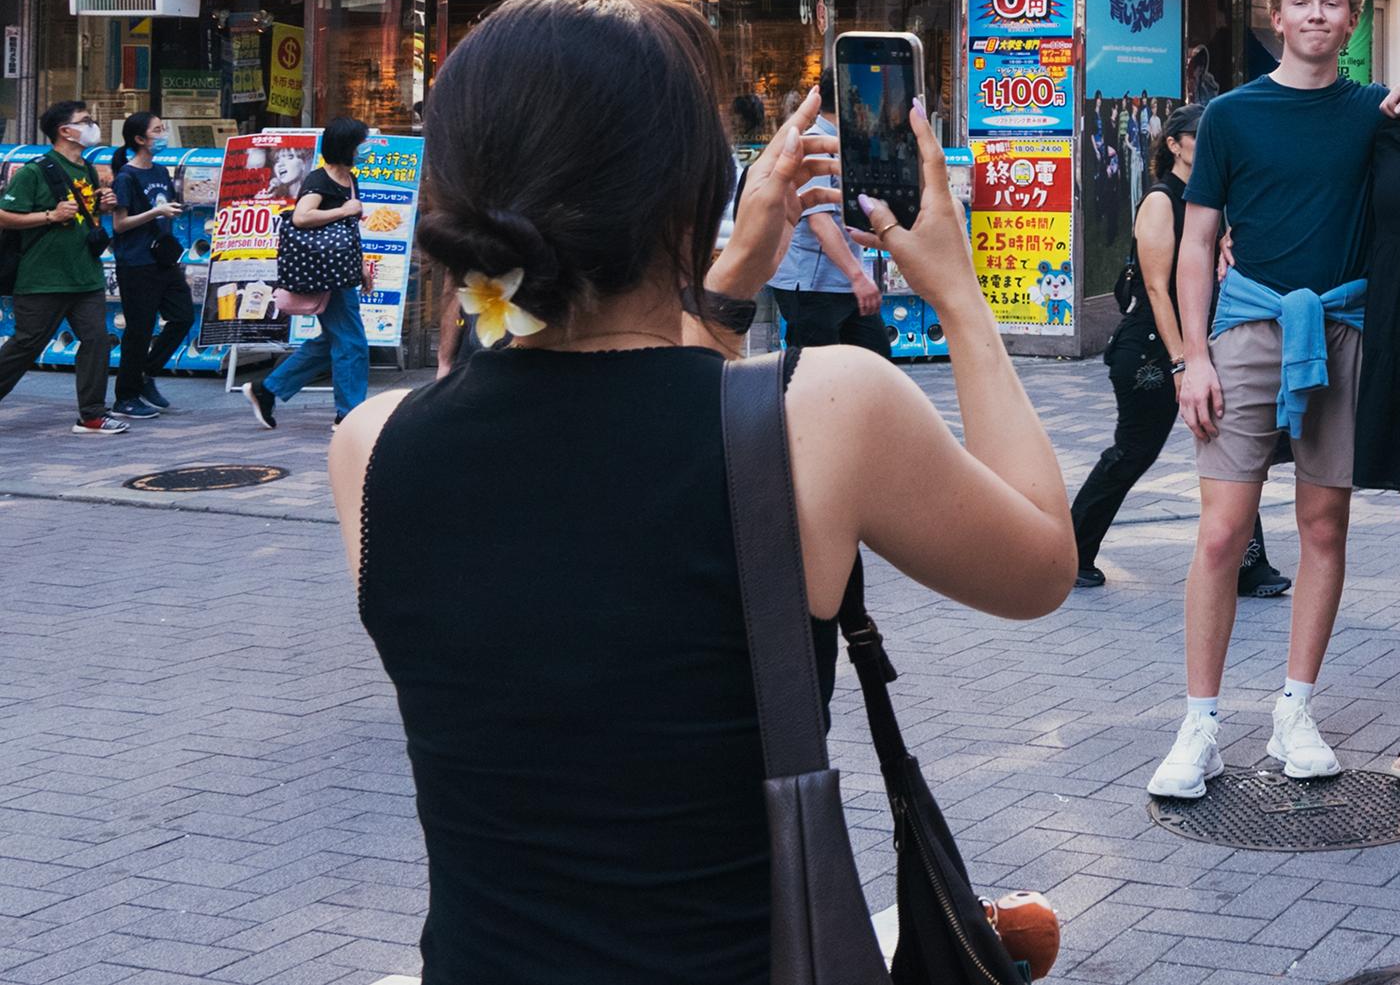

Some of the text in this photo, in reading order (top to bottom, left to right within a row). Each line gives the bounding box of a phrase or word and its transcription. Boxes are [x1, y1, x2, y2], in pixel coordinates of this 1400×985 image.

[162, 77, 221, 88] EXCHANGE
[271, 93, 302, 107] EXCHANG
[982, 78, 1064, 108] 1,100円
[986, 160, 1057, 186] 終電
[993, 185, 1048, 208] パック
[228, 238, 252, 250] person
[976, 231, 1066, 251] 2.5時間分の
[987, 254, 1030, 270] 料金で
